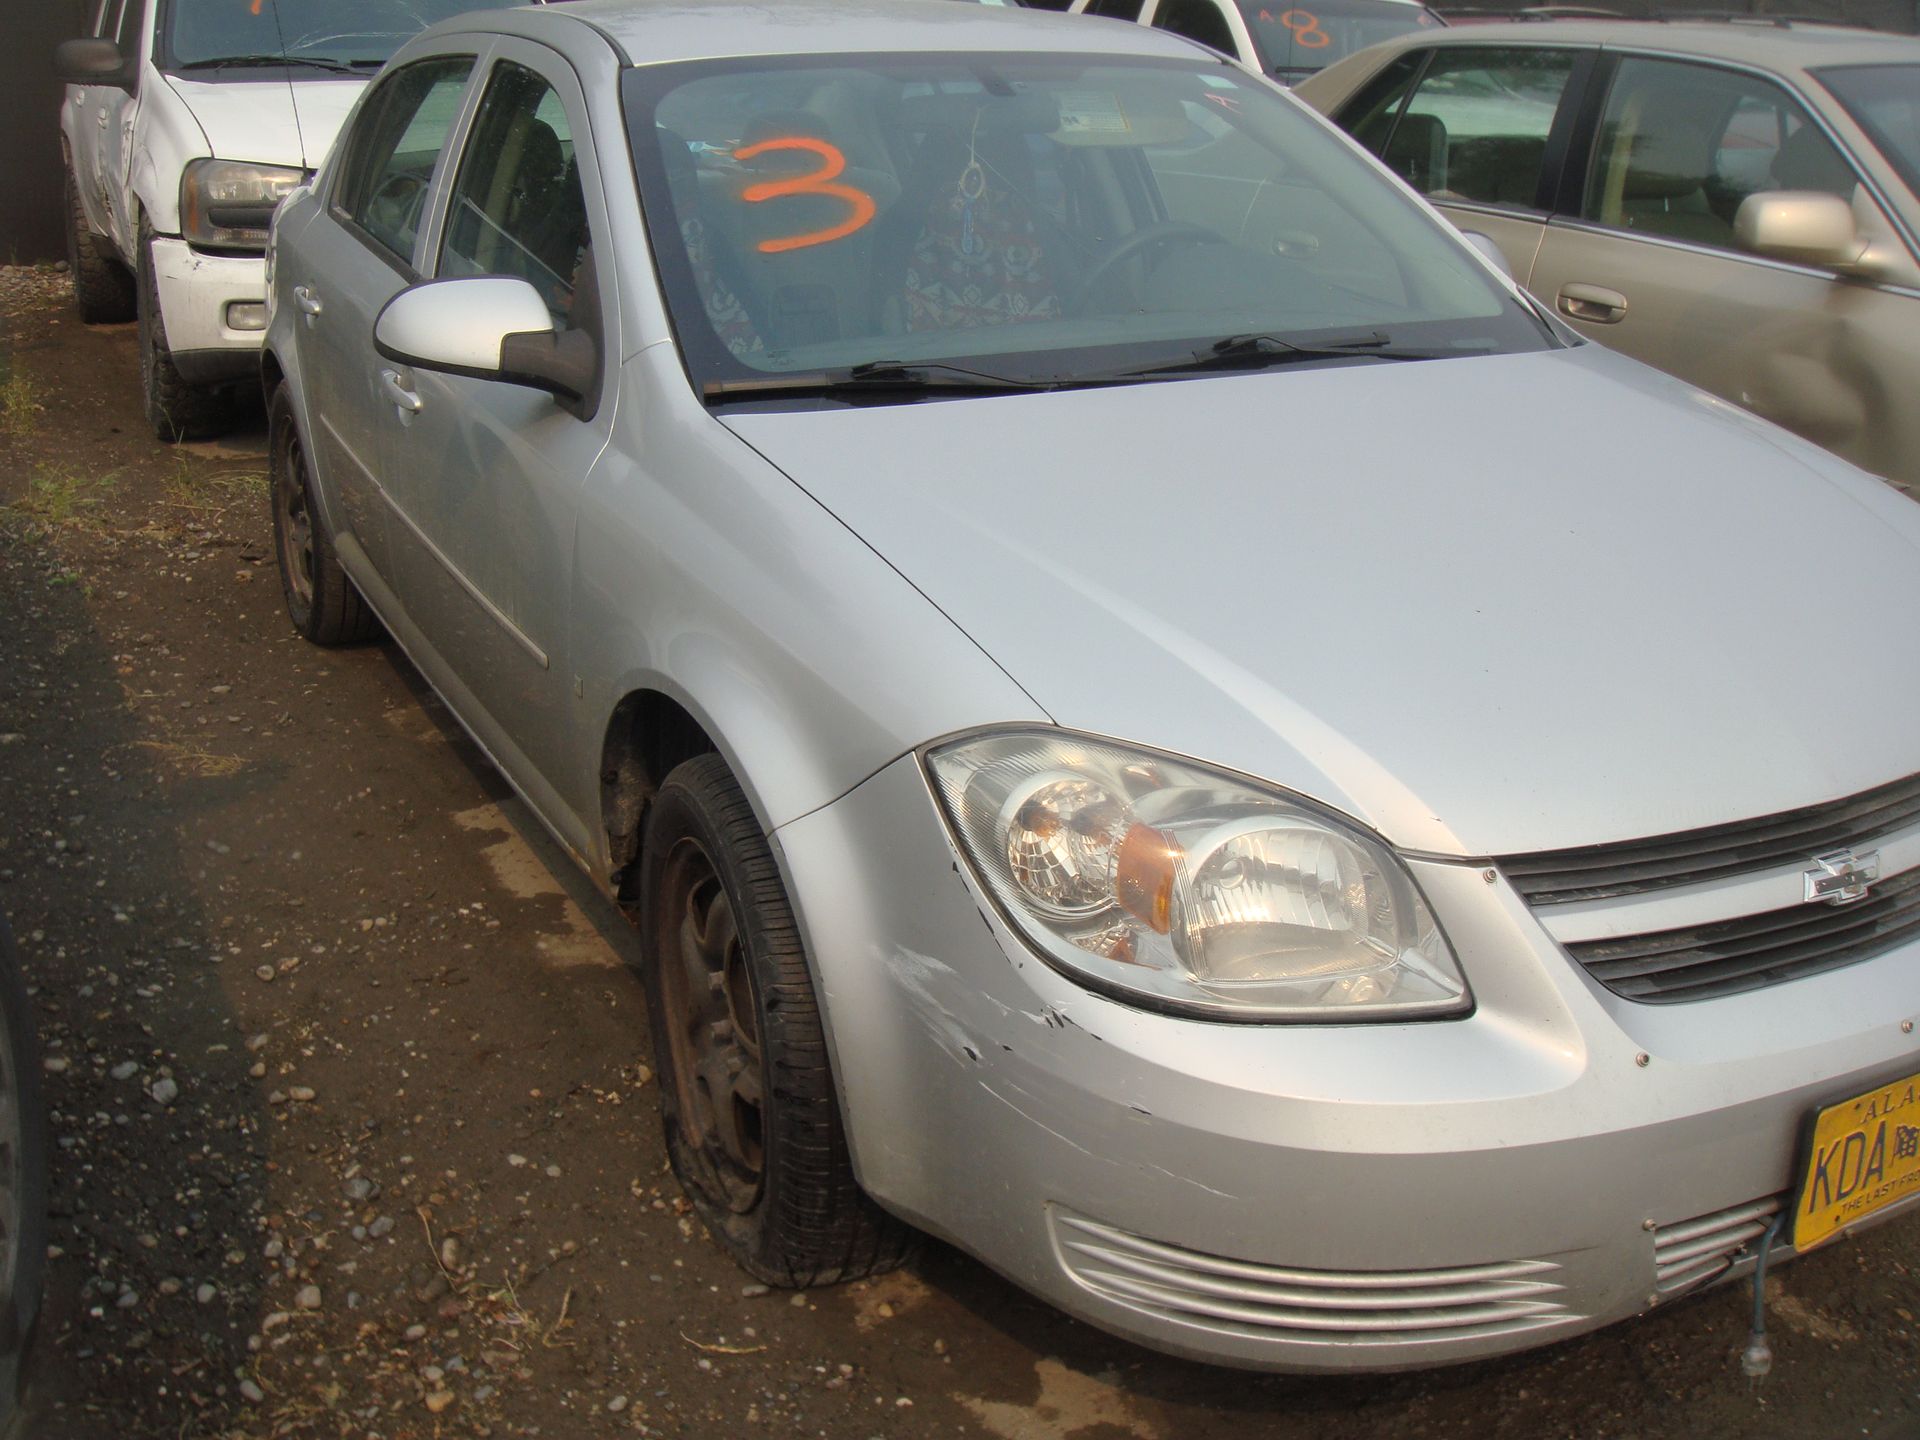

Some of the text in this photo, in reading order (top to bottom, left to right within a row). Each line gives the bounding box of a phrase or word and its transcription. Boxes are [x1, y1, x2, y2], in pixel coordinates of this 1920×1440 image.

[1281, 9, 1330, 48] 8
[733, 136, 876, 253] 3
[1860, 1083, 1920, 1124] ALA
[1808, 1119, 1886, 1214] KDA
[1841, 1195, 1863, 1213] THE
[1866, 1179, 1897, 1204] LAST
